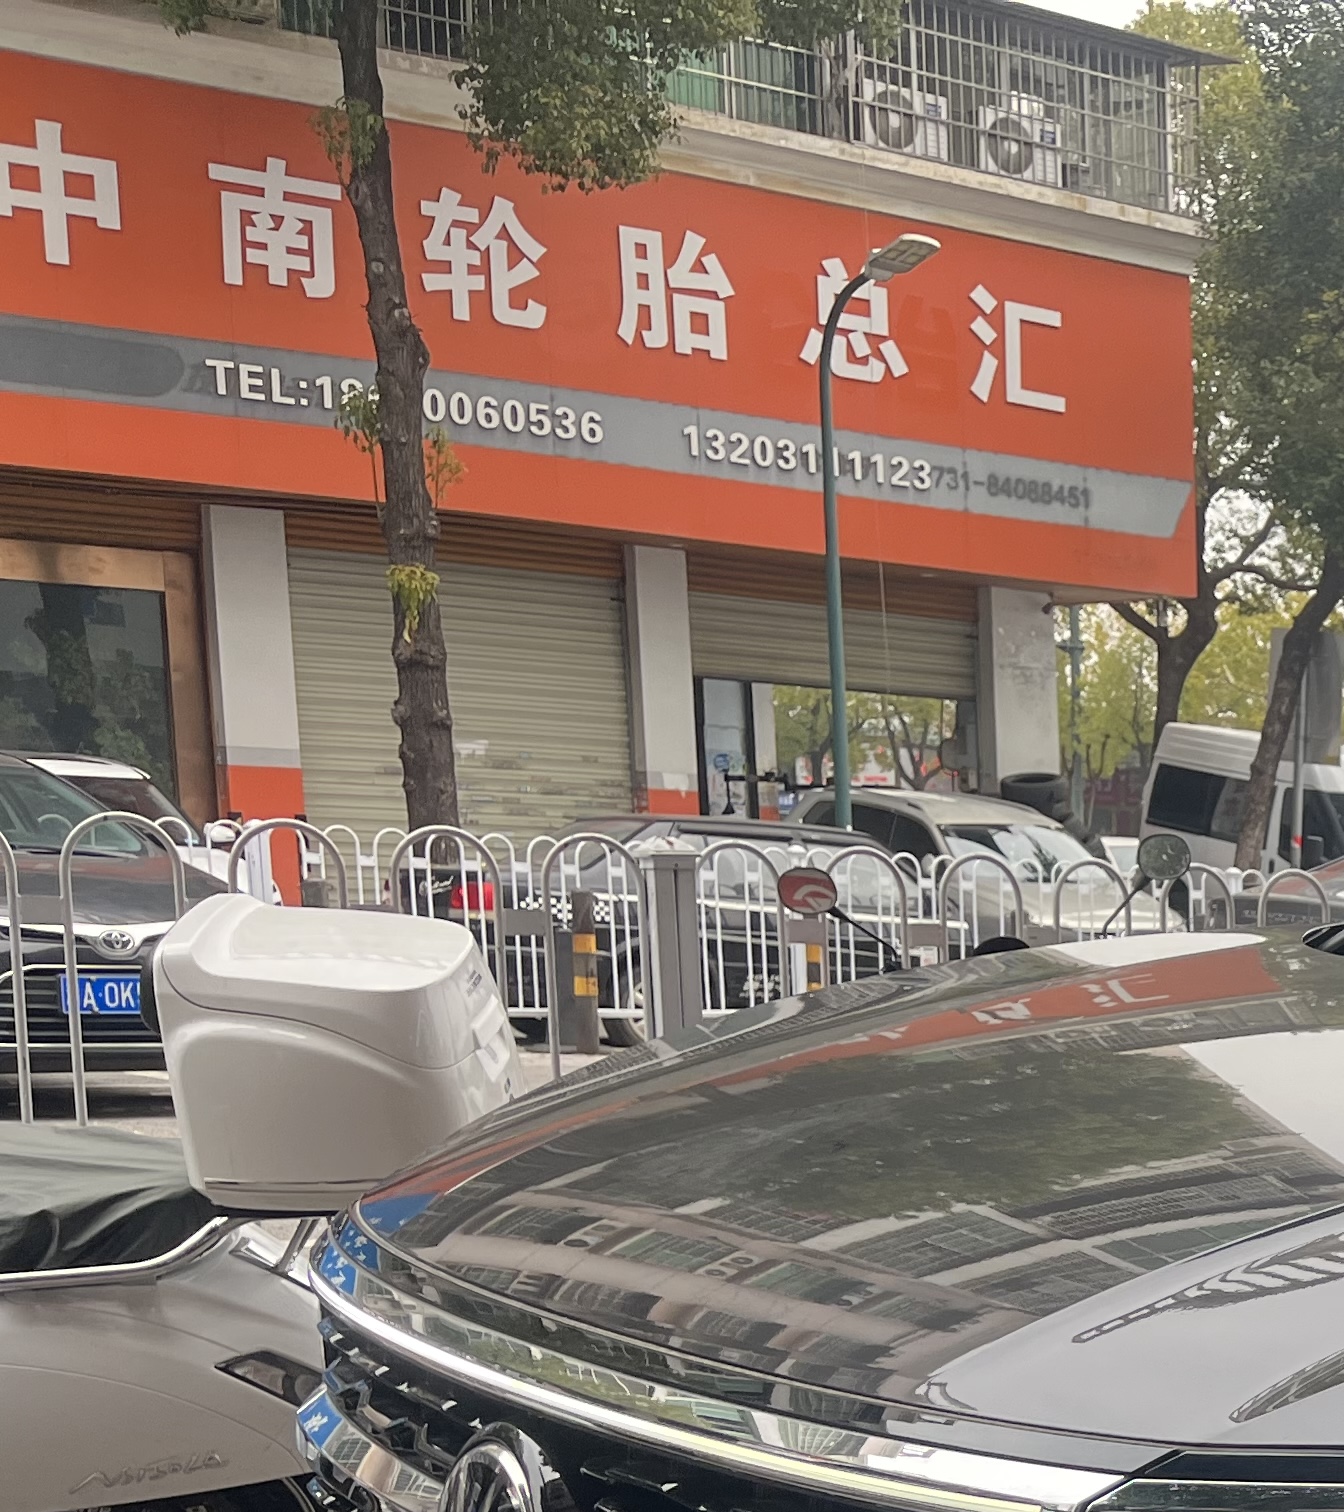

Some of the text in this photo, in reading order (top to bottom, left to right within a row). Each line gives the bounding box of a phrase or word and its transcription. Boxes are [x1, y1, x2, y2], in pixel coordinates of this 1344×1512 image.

[0, 118, 1067, 413] 中南轮胎总汇
